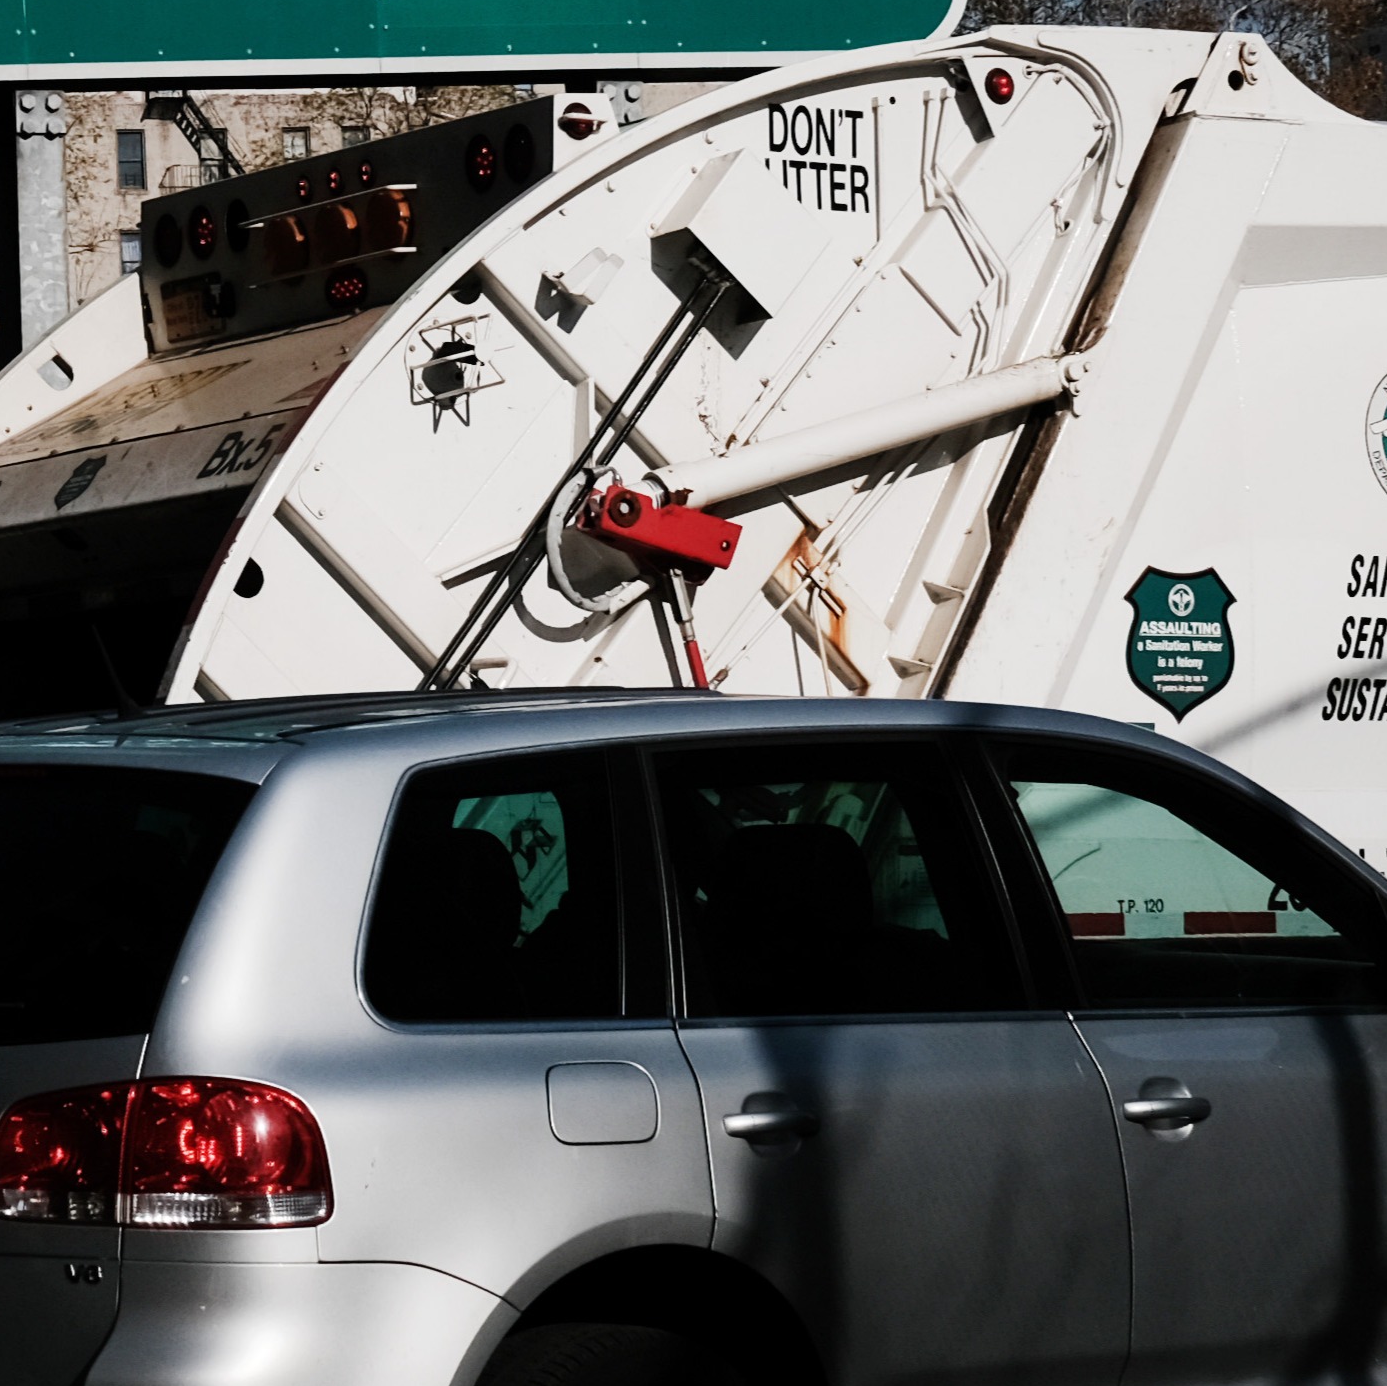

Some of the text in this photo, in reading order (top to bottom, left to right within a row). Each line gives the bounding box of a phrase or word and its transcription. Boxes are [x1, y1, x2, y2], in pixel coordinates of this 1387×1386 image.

[768, 103, 864, 158] DON'T
[765, 158, 870, 214] ITTER
[1139, 620, 1222, 636] ASSAULTING
[1146, 639, 1191, 652] Sanitation
[1192, 640, 1224, 653] Worker
[1144, 898, 1164, 913] 120
